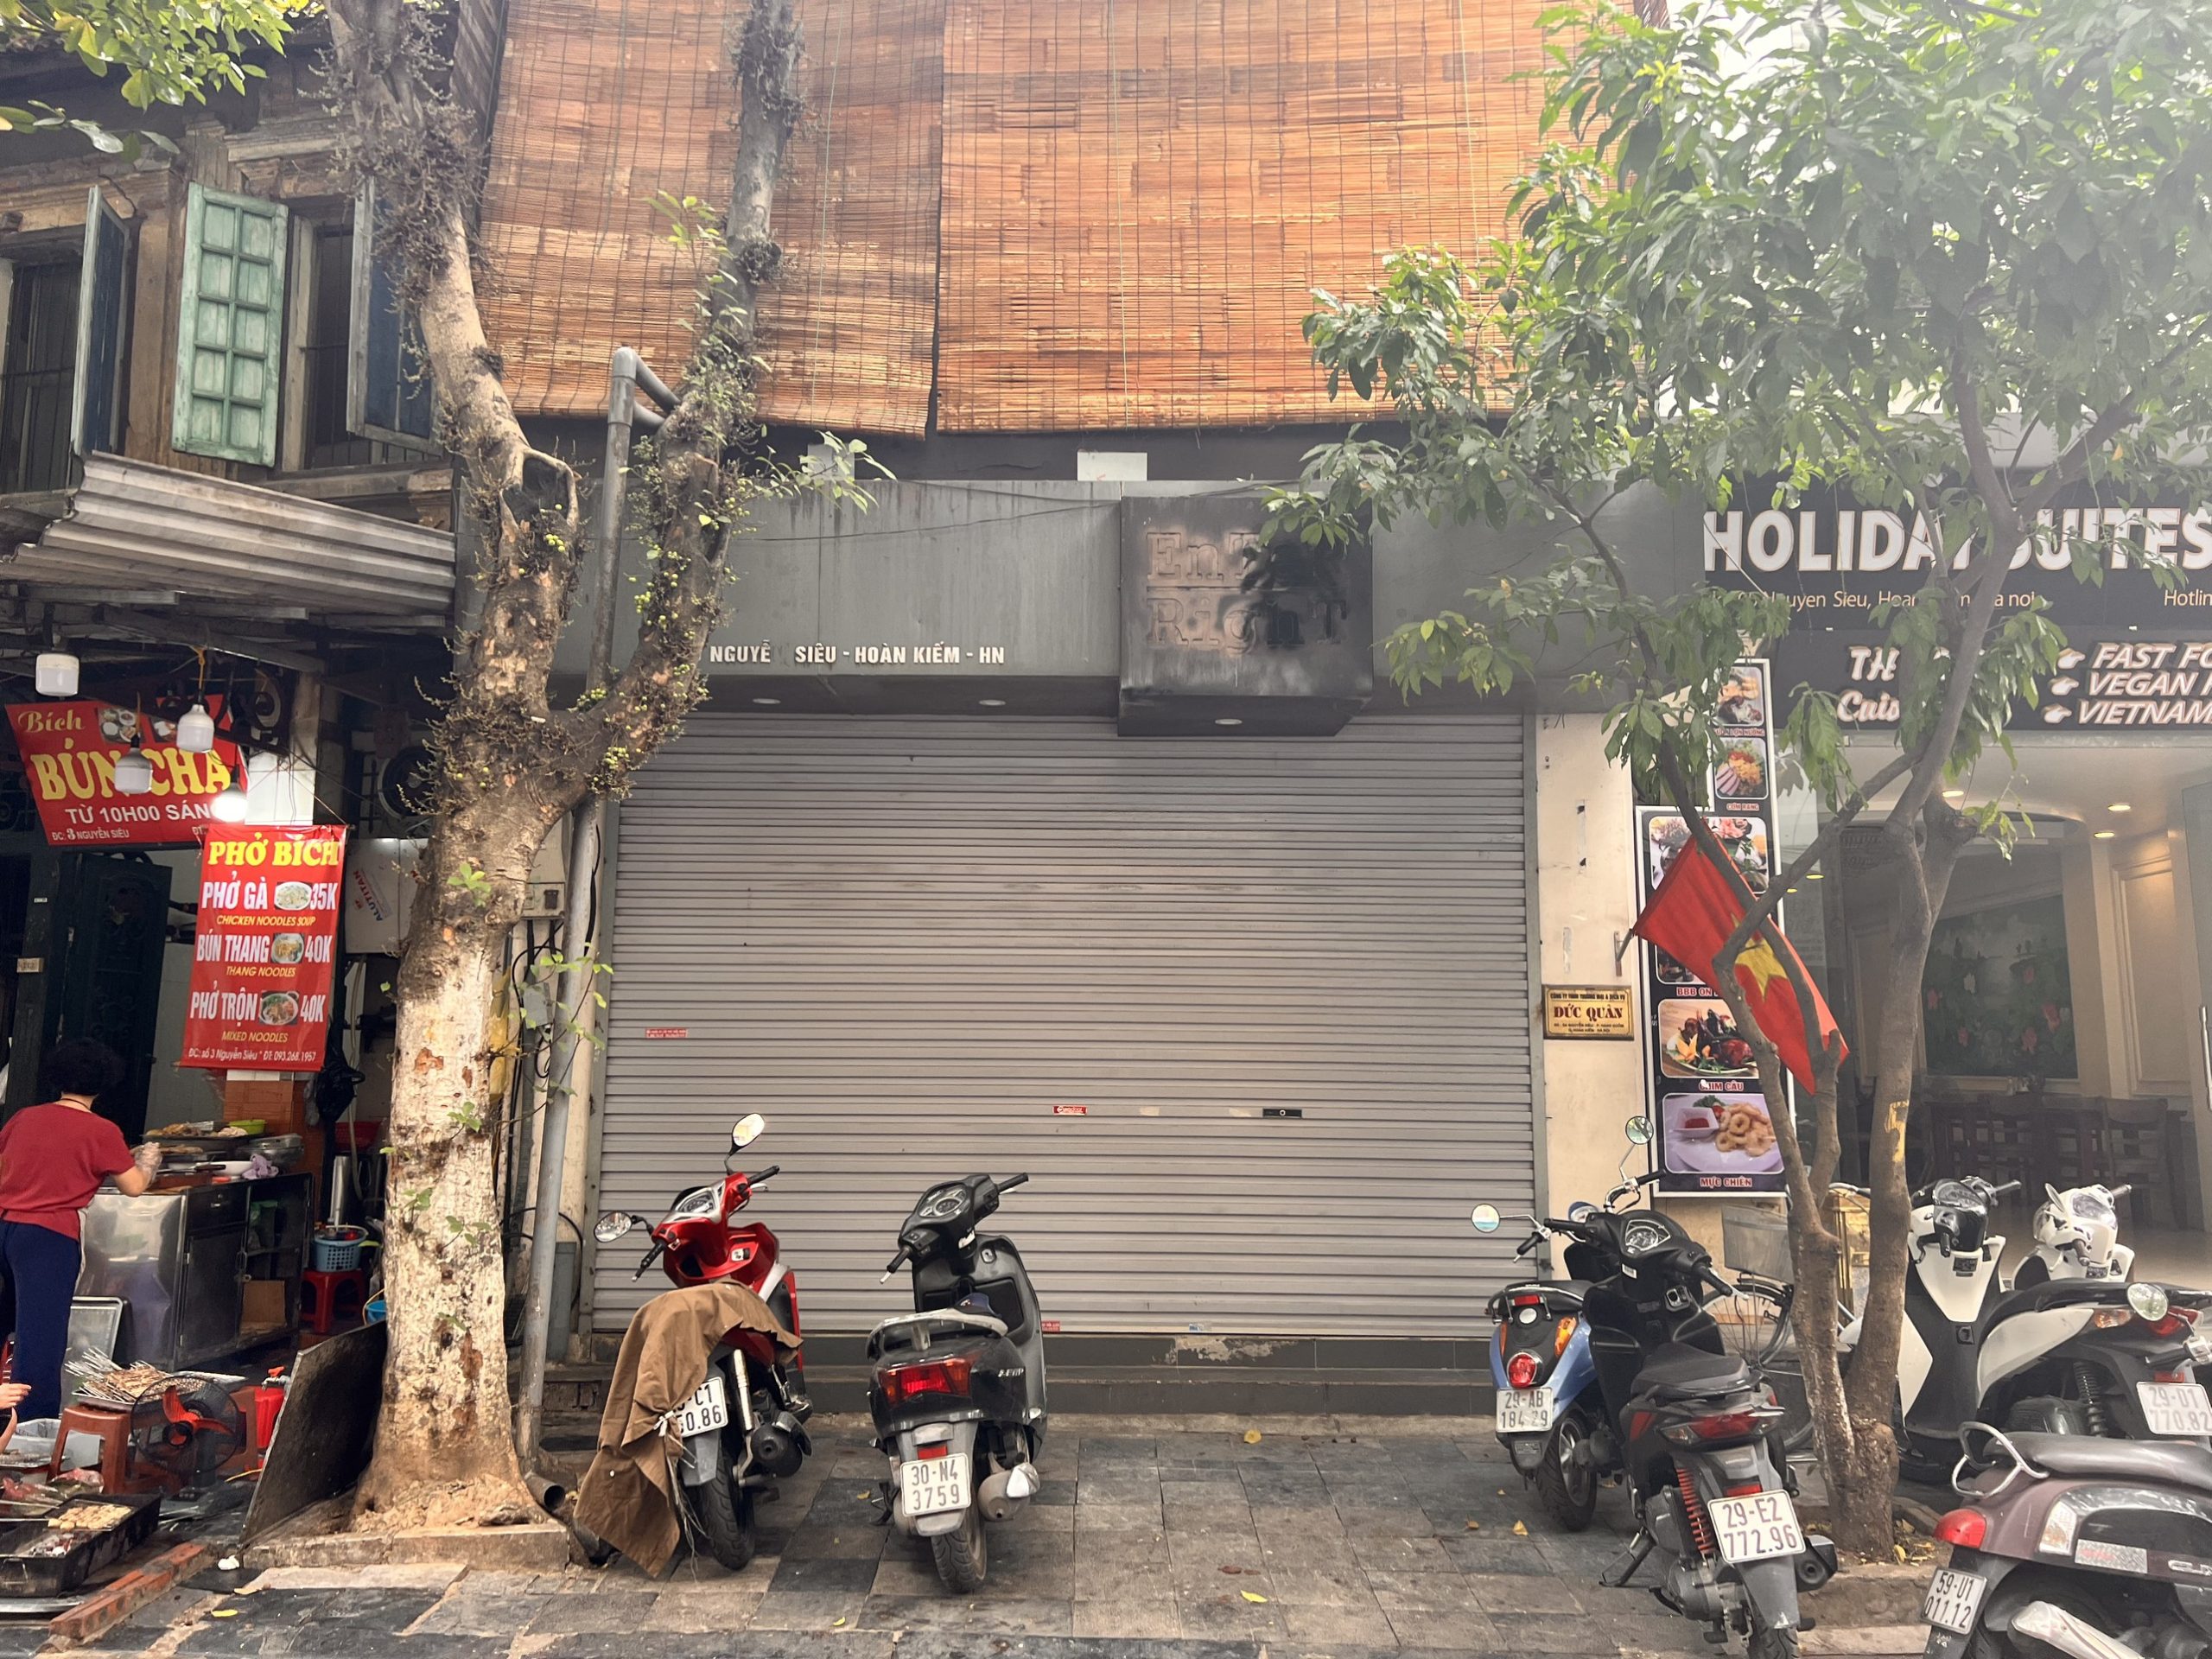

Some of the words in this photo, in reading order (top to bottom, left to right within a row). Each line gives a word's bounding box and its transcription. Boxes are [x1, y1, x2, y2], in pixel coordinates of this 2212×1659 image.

[1834, 591, 1872, 609] Sieu,
[795, 643, 836, 664] SIÊU
[855, 643, 906, 664] HOÀN
[913, 641, 960, 664] KIẾM
[979, 647, 1004, 664] HN
[2091, 643, 2177, 669] FAST
[2088, 671, 2199, 696] VEGAN
[18, 709, 85, 733] Bích
[65, 804, 93, 824] TỪ
[99, 805, 160, 823] 10H00
[165, 800, 213, 820] SÁN
[67, 829, 76, 840] 3
[207, 832, 270, 867] PHỞ
[272, 836, 341, 867] BÍCH
[201, 871, 241, 910] PHỞ
[244, 876, 269, 910] GÀ
[216, 915, 256, 925] CHICKEN
[257, 916, 296, 926] NOODLES
[297, 917, 316, 926] SOUP
[197, 927, 222, 962] BÚN
[225, 934, 270, 963] THANG
[304, 934, 333, 963] 40K
[226, 966, 257, 976] THANG
[258, 967, 296, 977] NOODLES
[190, 980, 219, 1020] PHỞ
[221, 987, 258, 1027] TRỘN
[300, 995, 326, 1022] 40K
[221, 1031, 247, 1041] MIXED
[248, 1033, 289, 1043] NOODLES
[1700, 1176, 1722, 1189] MỰC
[1723, 1175, 1753, 1187] CHIÊN
[1505, 1390, 1544, 1408] 29-AB
[912, 1459, 957, 1486] 30-N4
[913, 1484, 960, 1510] 3759
[1722, 1497, 1783, 1528] 29-E2
[1724, 1524, 1797, 1558] 772.96
[1936, 1572, 1974, 1601] 59-U1
[1924, 1595, 1972, 1628] 011.12
